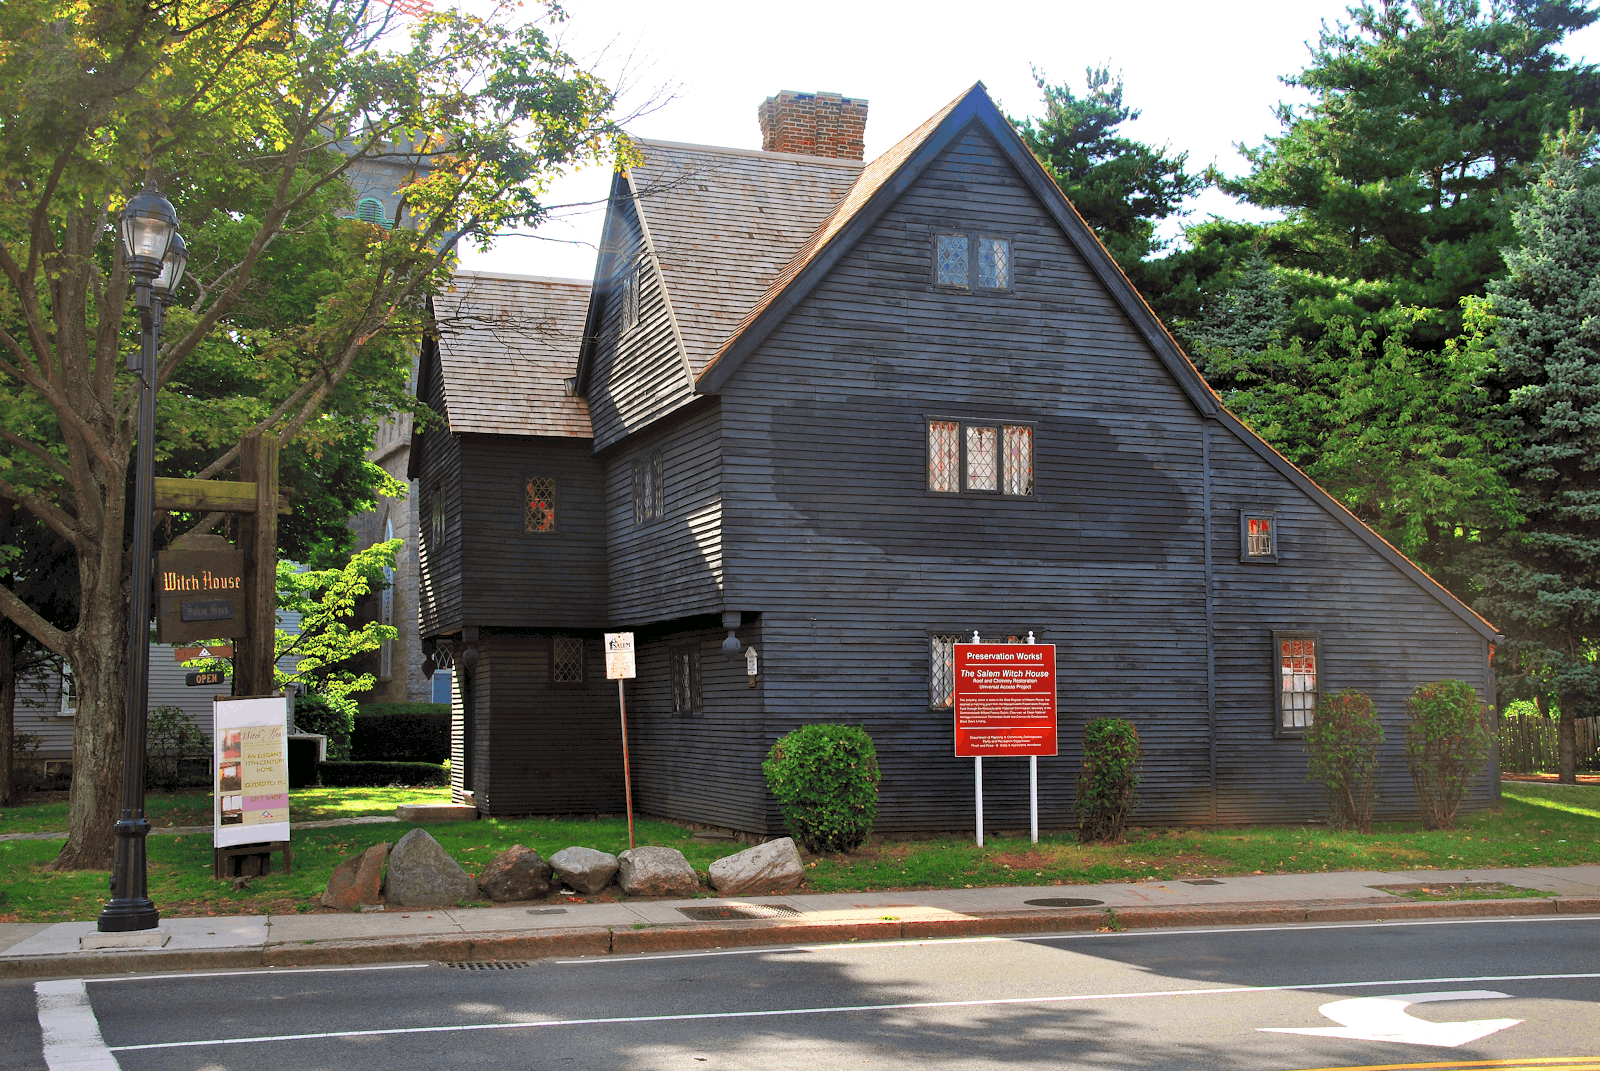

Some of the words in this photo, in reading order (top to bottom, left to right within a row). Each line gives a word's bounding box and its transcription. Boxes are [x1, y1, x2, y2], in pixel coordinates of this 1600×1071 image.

[164, 572, 199, 591] Witch
[202, 571, 240, 590] House
[967, 652, 1014, 660] Preservation
[961, 669, 975, 677] The
[977, 669, 1000, 677] Salem
[1002, 669, 1023, 677] Witch
[1025, 669, 1049, 677] House
[196, 673, 217, 683] OPEN
